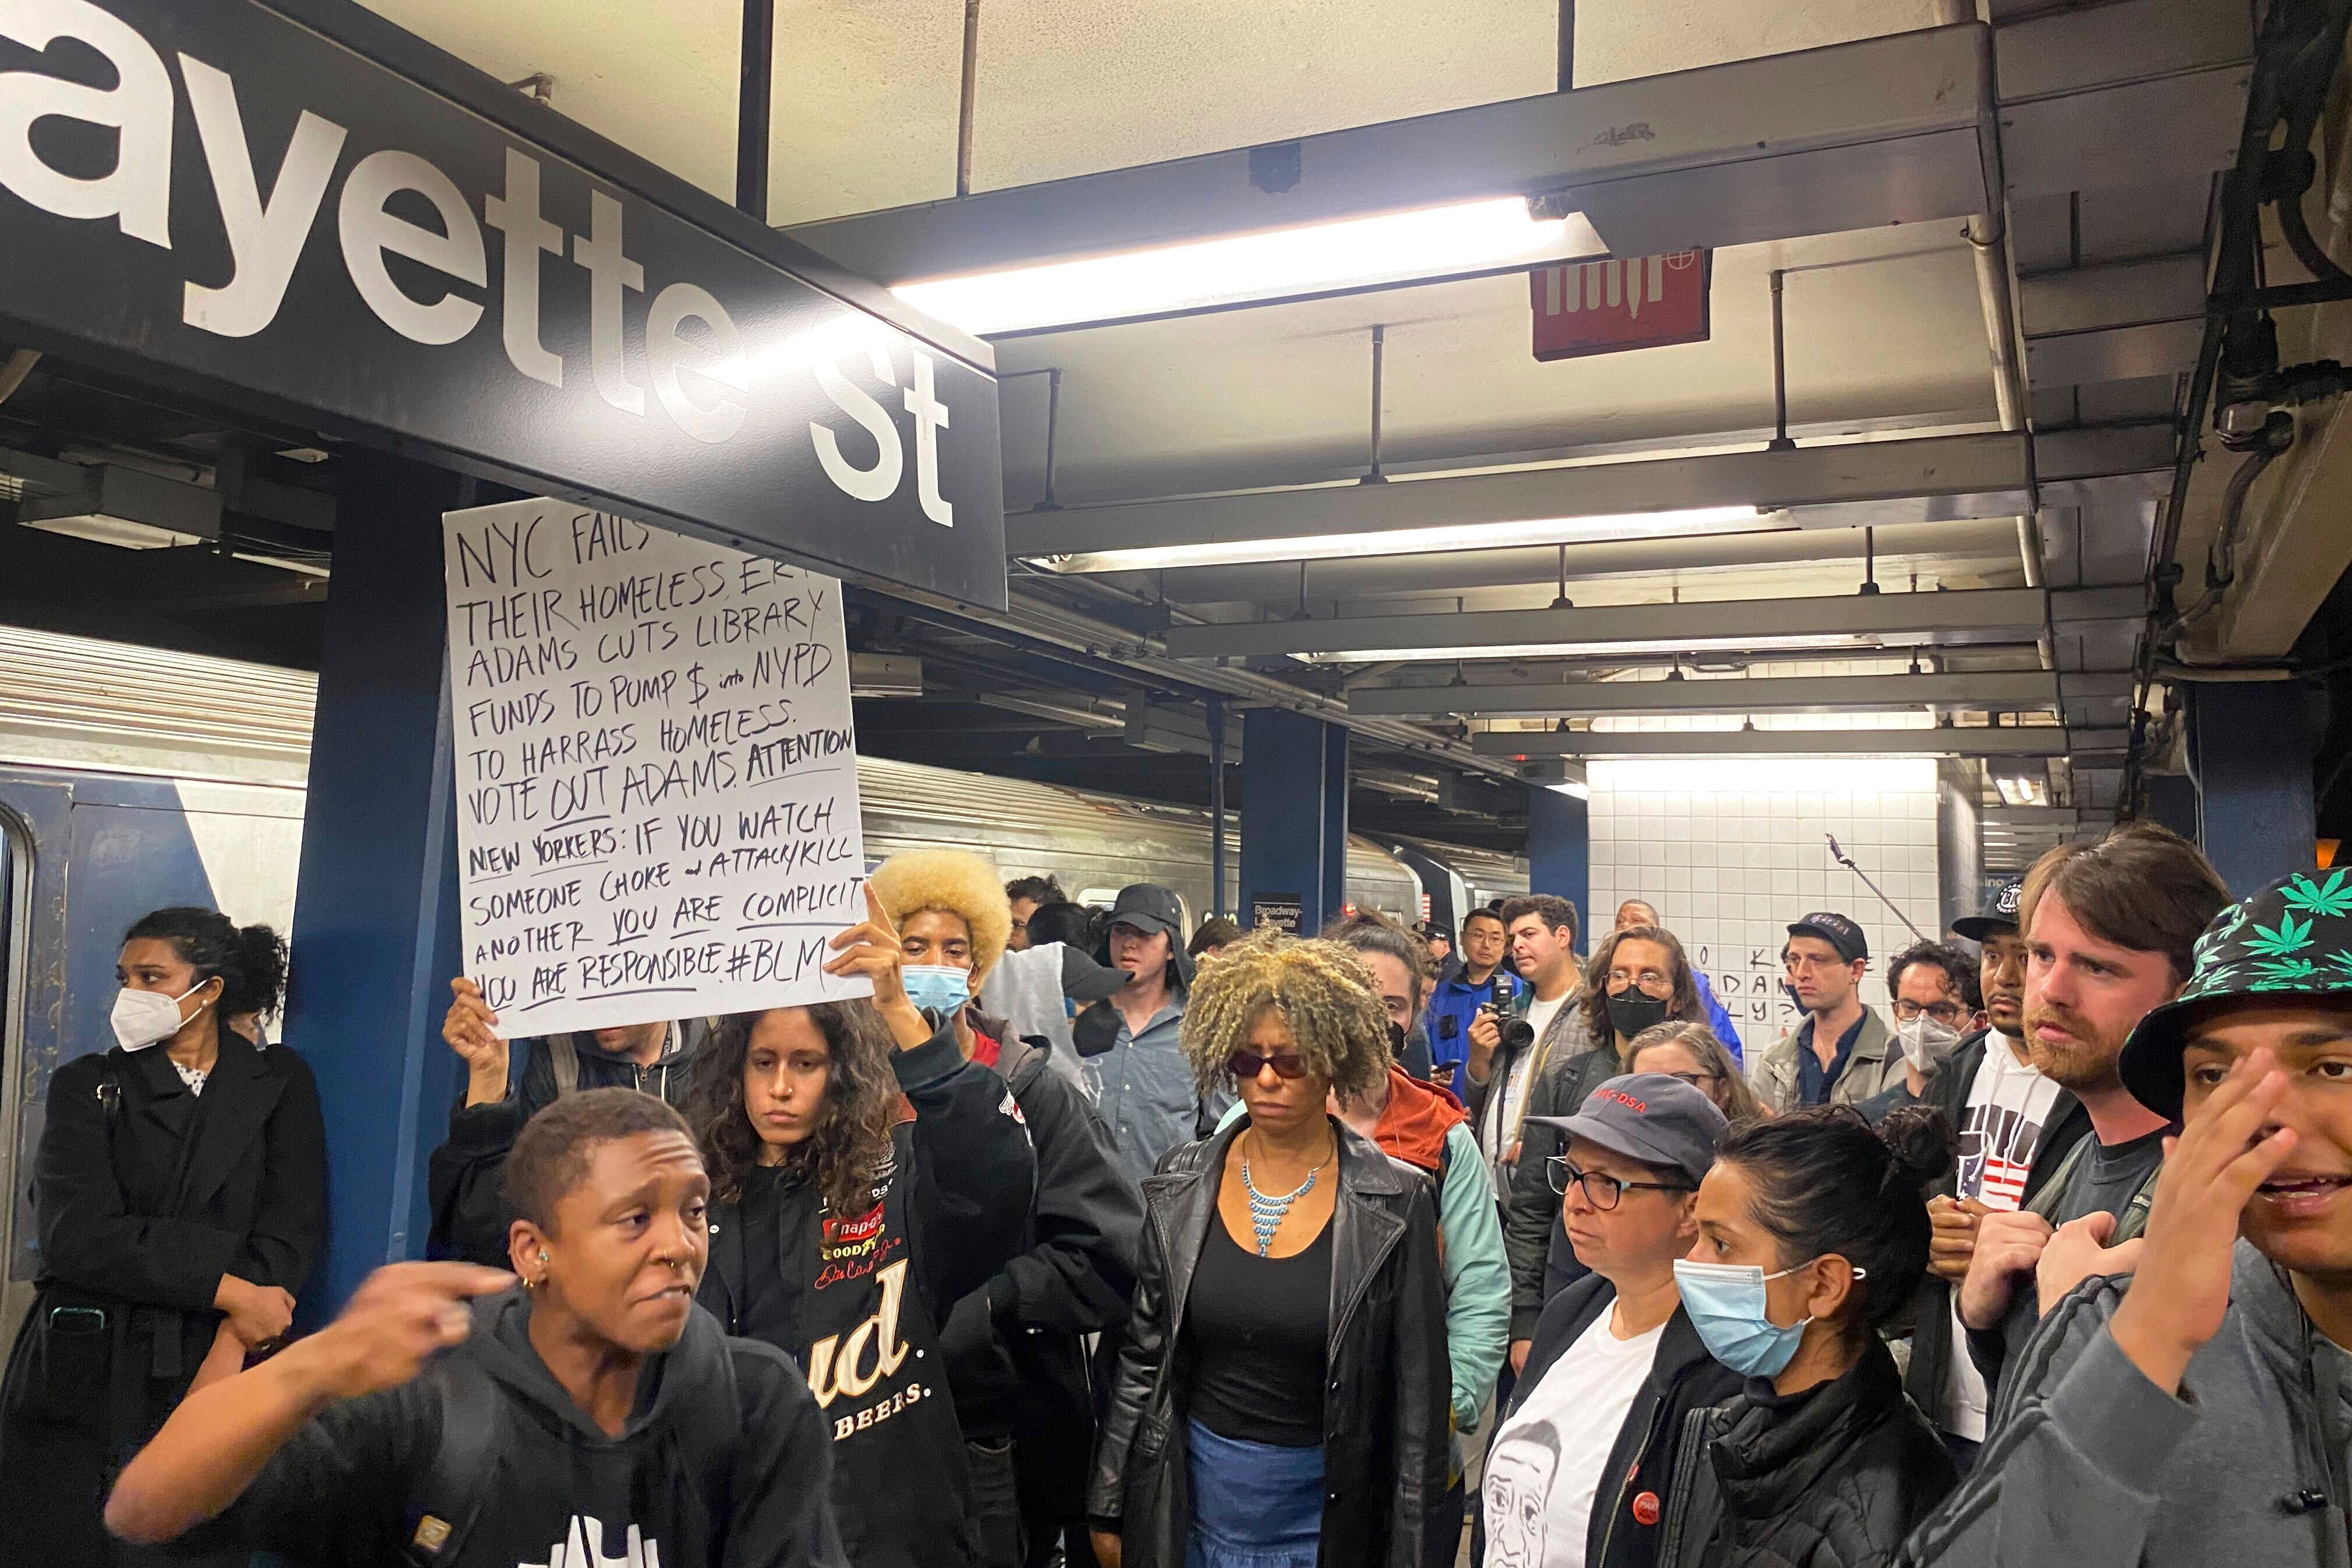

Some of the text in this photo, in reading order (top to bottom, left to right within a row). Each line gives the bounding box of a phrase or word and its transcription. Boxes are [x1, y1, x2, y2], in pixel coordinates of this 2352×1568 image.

[808, 327, 954, 528] St
[457, 513, 650, 587] NYC FAILS
[456, 589, 577, 646] THEIR
[467, 588, 824, 687] ADAMS CUTS LIBRARY
[468, 642, 833, 738] FUNDS TO PUMP $ into NYPD
[469, 699, 797, 782] TO HARRASS HOMELESS.
[469, 726, 855, 826] VOTE OUT ADAMS. ATTENTION
[469, 797, 835, 876] NEW YORKERS: IF YOU WATCH
[470, 879, 582, 926] SOMEONE
[599, 862, 671, 902] CHOKE
[475, 877, 864, 964] ANOTHER YOU ARE COMPLICIT
[474, 974, 516, 1008] YOU
[532, 962, 570, 1001] ARE
